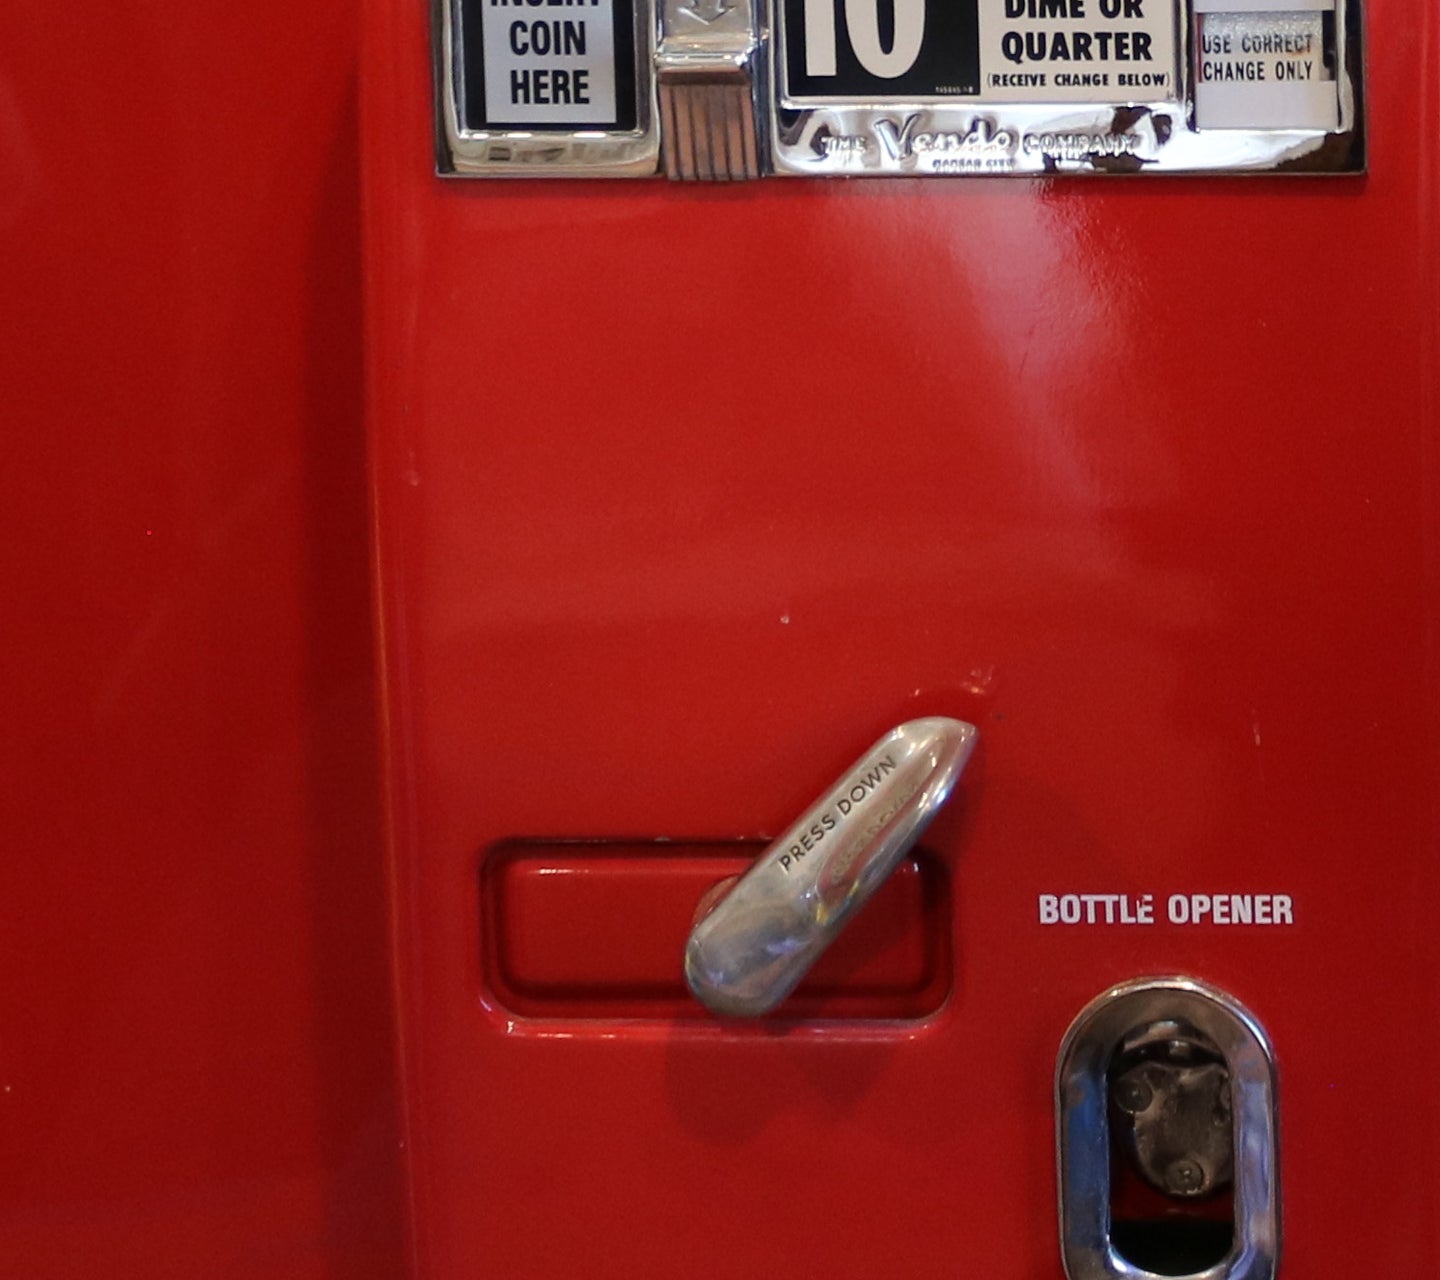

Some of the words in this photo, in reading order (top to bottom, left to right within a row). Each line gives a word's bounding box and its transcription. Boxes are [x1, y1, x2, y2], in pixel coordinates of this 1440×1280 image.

[509, 19, 587, 56] COIN
[1001, 31, 1153, 65] QUARTER
[1202, 34, 1232, 54] USE
[1241, 33, 1313, 55] CORRECT
[510, 69, 591, 105] HERE
[987, 72, 1047, 88] (RECEIVE
[1054, 73, 1110, 87] CHANGE
[1117, 72, 1170, 88] BELOW)
[1203, 61, 1266, 81] CHANGE
[1275, 61, 1313, 81] ONLY
[872, 114, 1013, 162] Vendo
[777, 813, 837, 873] PRESS
[836, 754, 898, 817] DOWN
[1038, 894, 1155, 925] BOTTLE
[1167, 894, 1294, 925] OPENER
